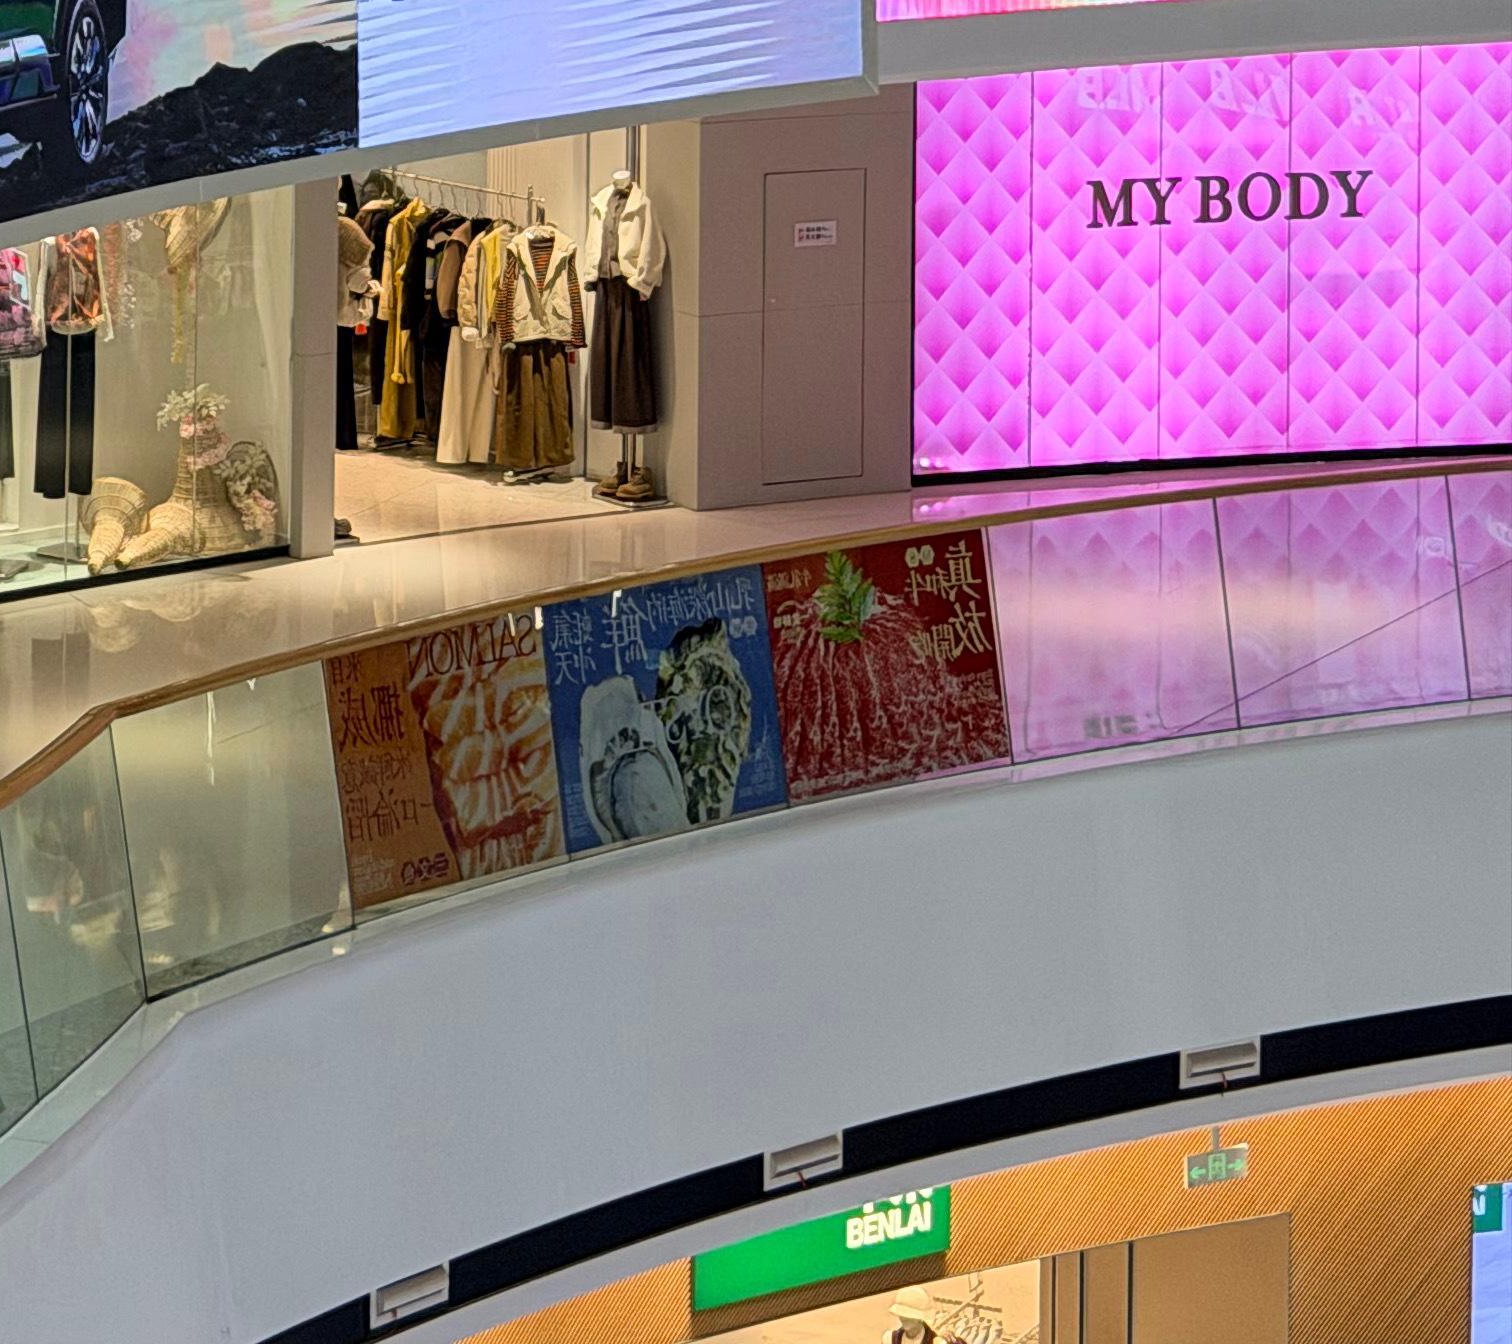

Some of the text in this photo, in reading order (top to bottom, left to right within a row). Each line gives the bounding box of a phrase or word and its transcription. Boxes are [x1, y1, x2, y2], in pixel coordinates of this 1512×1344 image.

[1086, 169, 1374, 230] MY BODY
[845, 1200, 932, 1249] BENLAI
